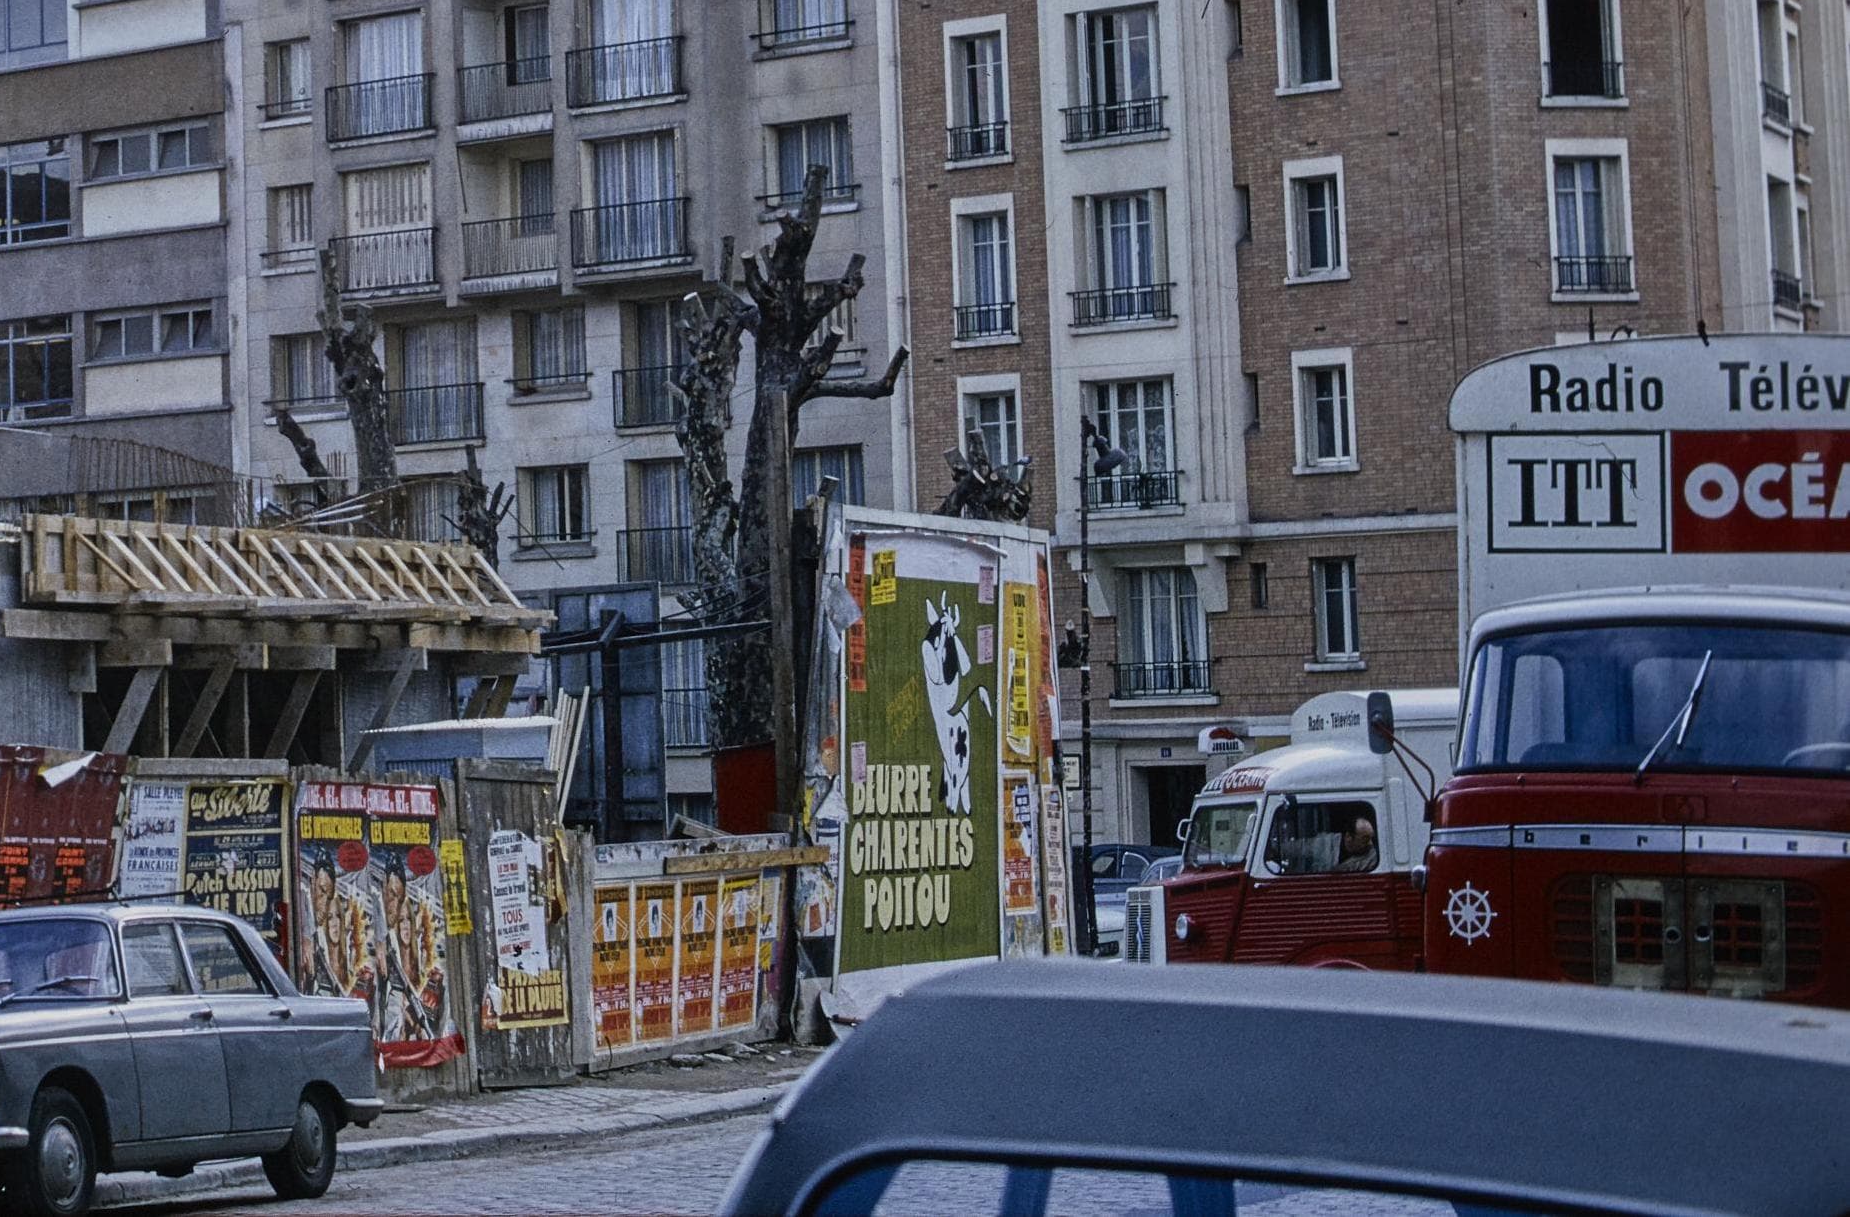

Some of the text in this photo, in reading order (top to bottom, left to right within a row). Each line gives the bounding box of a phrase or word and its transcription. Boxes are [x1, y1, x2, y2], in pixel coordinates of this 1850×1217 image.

[1529, 362, 1664, 413] Radio
[1507, 458, 1638, 527] ITT
[1308, 710, 1360, 731] Radio Télévision
[144, 785, 183, 799] SALLE PLEYEL
[852, 764, 932, 816] BEURRE
[850, 818, 974, 875] CHARENTES
[127, 860, 178, 872] FRANÇAISES
[227, 867, 282, 892] CASSIDY
[236, 891, 267, 916] KID
[864, 873, 950, 931] POITOU
[502, 908, 523, 925] TOUS
[516, 987, 526, 1014] LA
[528, 984, 563, 1013] PLUIE
